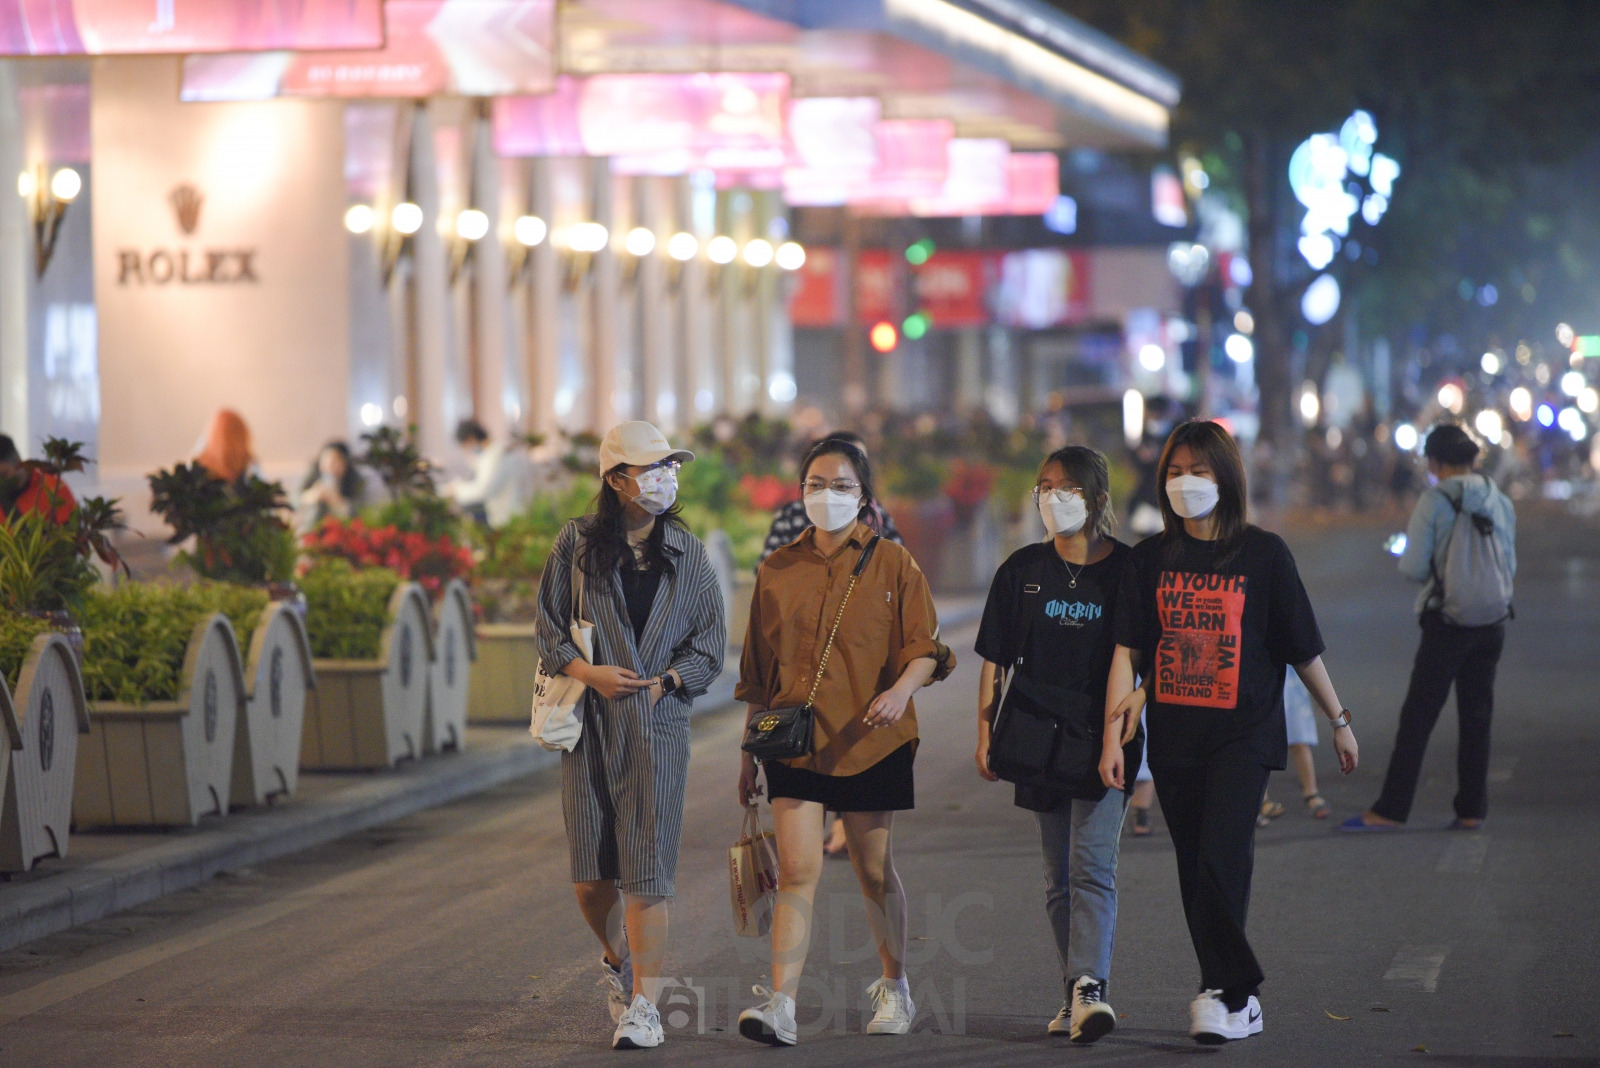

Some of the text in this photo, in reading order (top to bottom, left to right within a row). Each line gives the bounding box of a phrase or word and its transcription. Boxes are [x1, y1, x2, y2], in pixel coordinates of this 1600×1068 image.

[116, 250, 258, 285] ROLEX
[1157, 571, 1248, 594] IN YOUTH
[1162, 590, 1195, 609] WE
[1205, 603, 1223, 611] learn
[1162, 610, 1226, 631] LEARN
[1218, 634, 1236, 671] WE
[1176, 686, 1212, 699] STAND
